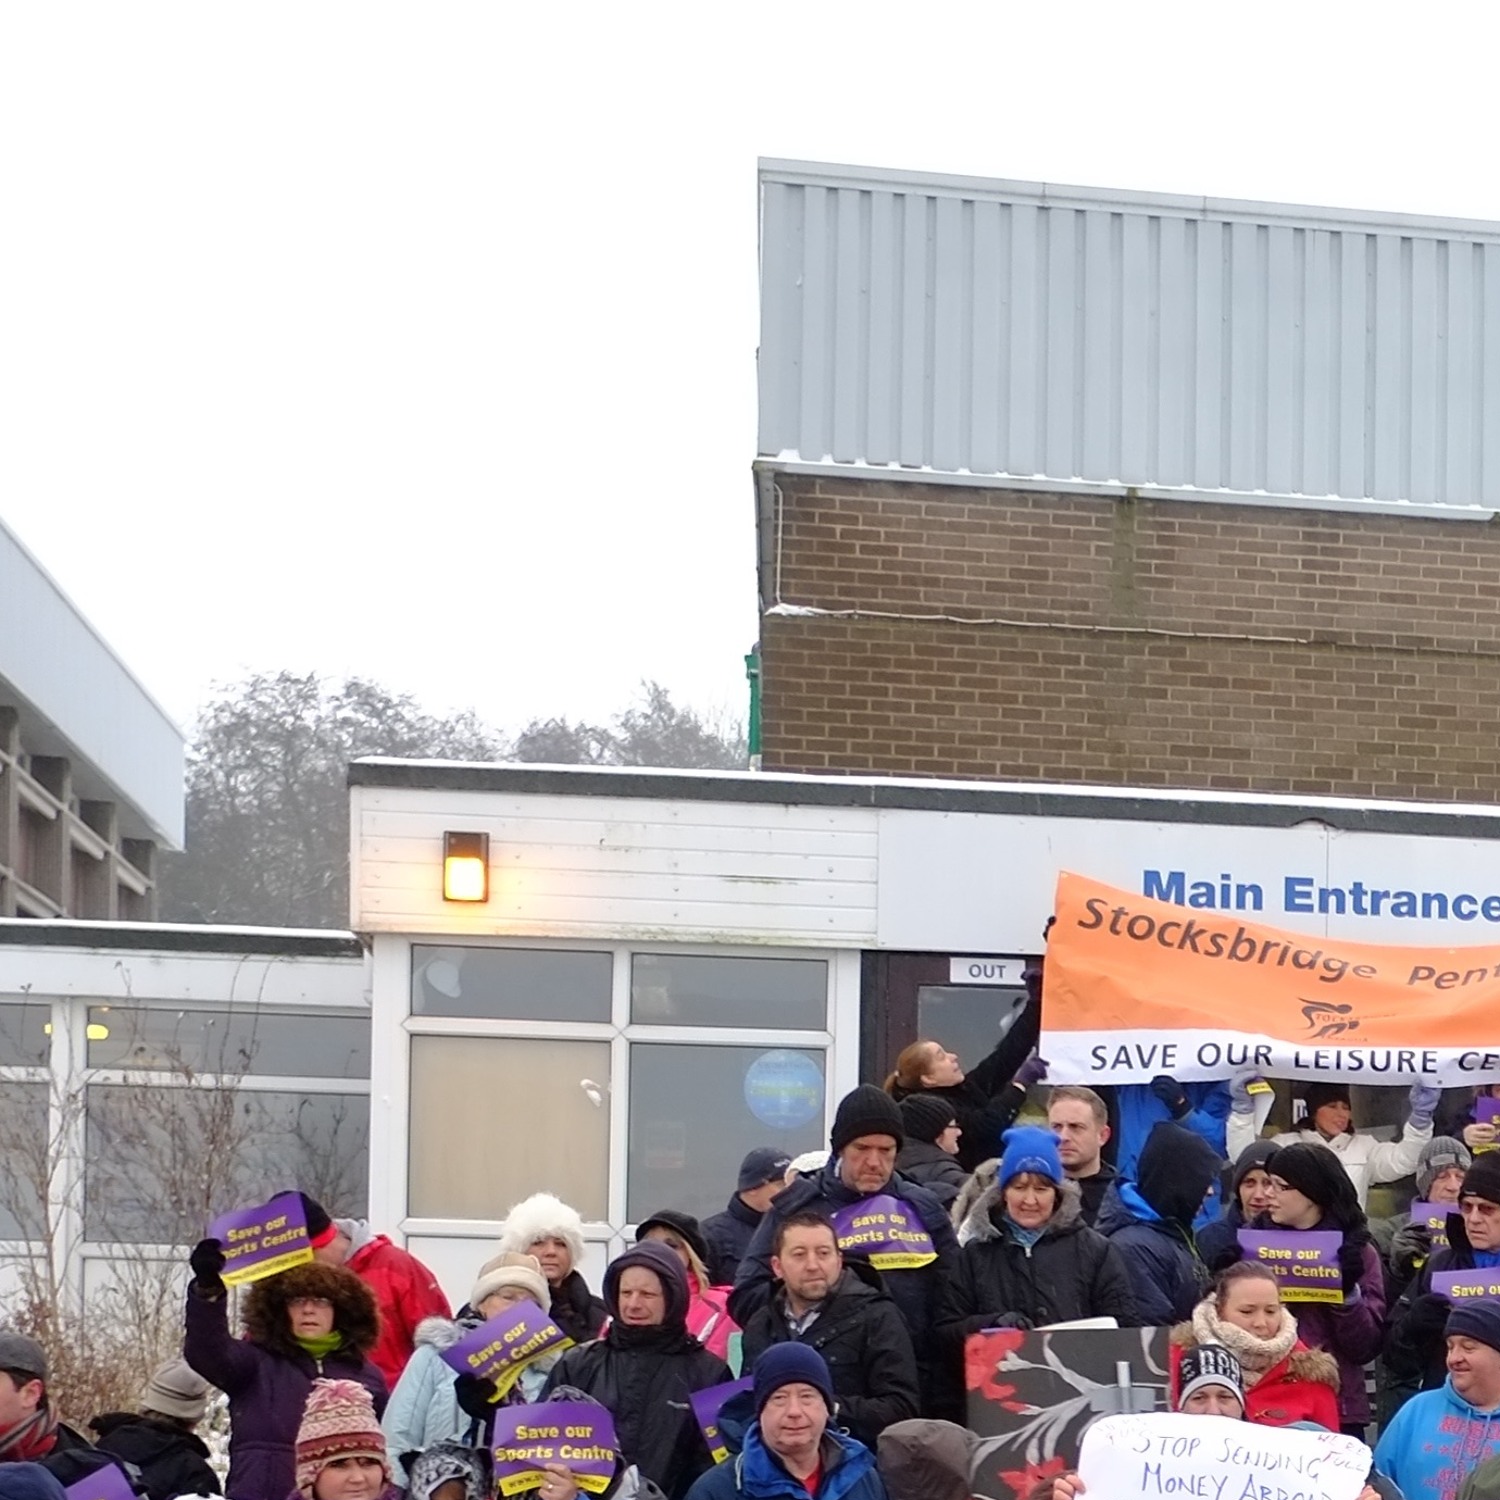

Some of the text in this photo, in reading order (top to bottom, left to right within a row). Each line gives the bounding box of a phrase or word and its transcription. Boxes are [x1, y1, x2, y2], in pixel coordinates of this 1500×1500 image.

[1143, 870, 1263, 911] Main
[1077, 898, 1377, 983] Stocksbridge
[968, 964, 1006, 979] OUT
[1091, 1044, 1177, 1070] SAVE
[1197, 1043, 1272, 1067] OUR
[1294, 1049, 1437, 1073] LEISURE
[227, 1214, 287, 1242] Save our
[852, 1213, 885, 1228] Save
[262, 1226, 306, 1248] Centre
[838, 1228, 929, 1249] Sports Centre
[1258, 1247, 1320, 1259] Save our
[1292, 1265, 1340, 1278] Centre
[1451, 1285, 1484, 1297] Save
[467, 1321, 528, 1368] Save our
[510, 1324, 558, 1360] Centre
[515, 1425, 593, 1440] Save our
[495, 1444, 615, 1462] Sports Centre
[1133, 1436, 1322, 1484] STOP SENDING
